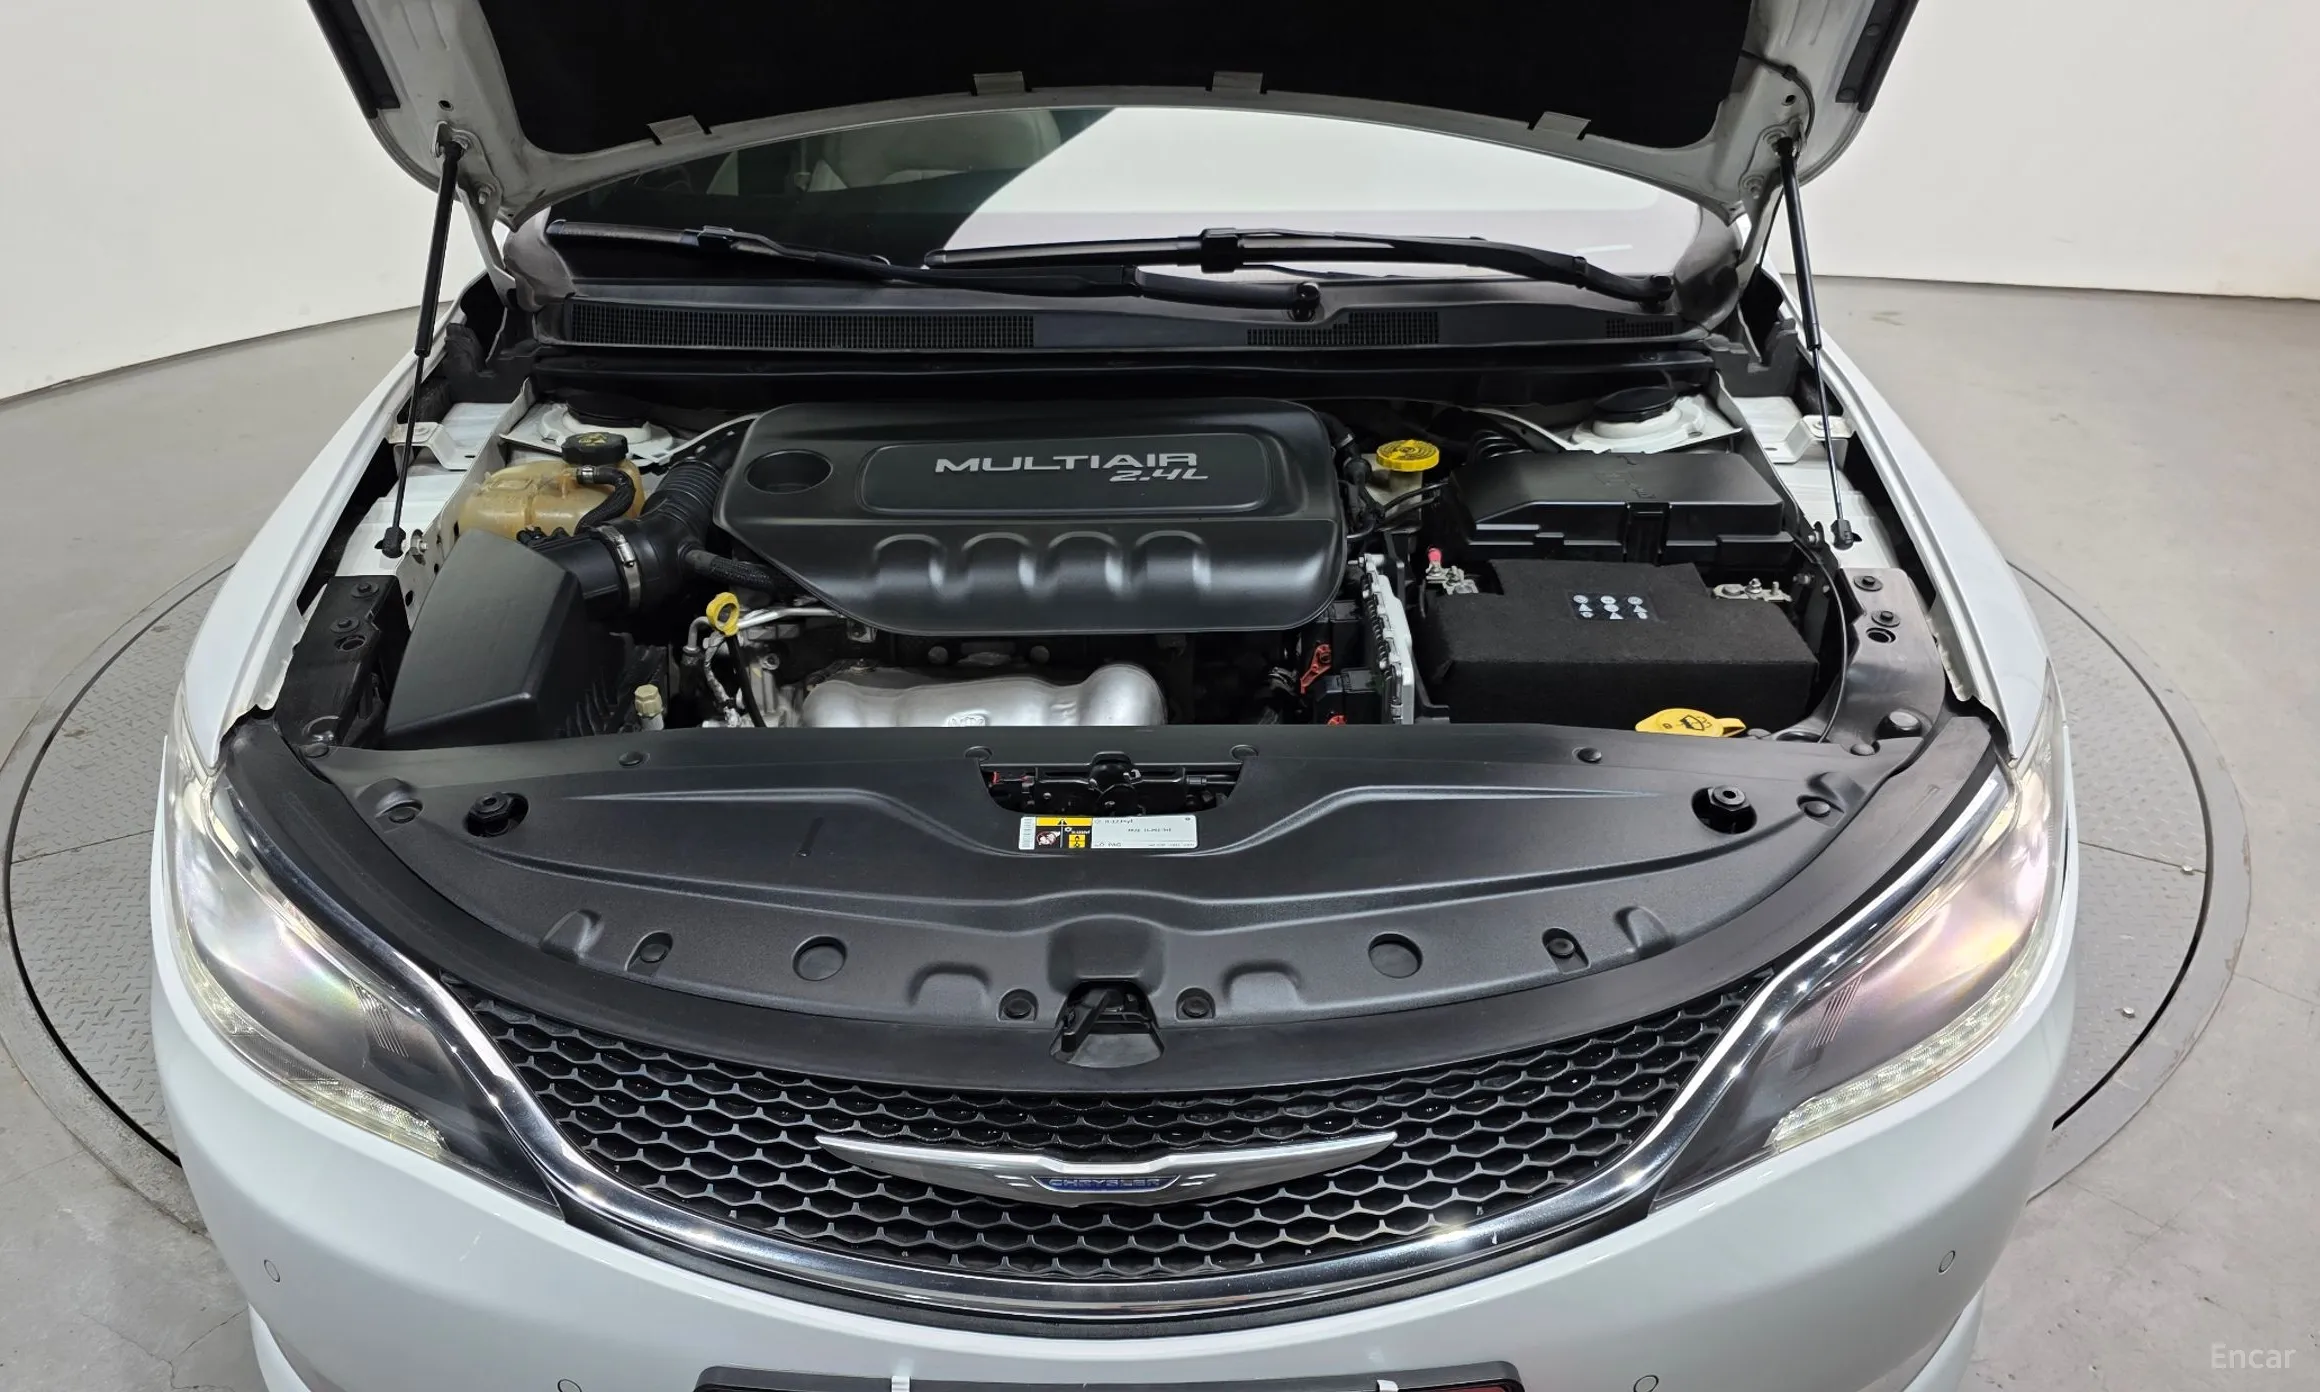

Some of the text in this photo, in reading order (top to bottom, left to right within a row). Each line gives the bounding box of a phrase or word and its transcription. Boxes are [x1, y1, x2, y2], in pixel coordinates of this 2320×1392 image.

[935, 452, 1198, 473] MULTIAIR
[1109, 468, 1209, 482] 2.4L
[1048, 1179, 1160, 1187] CHRYSLER
